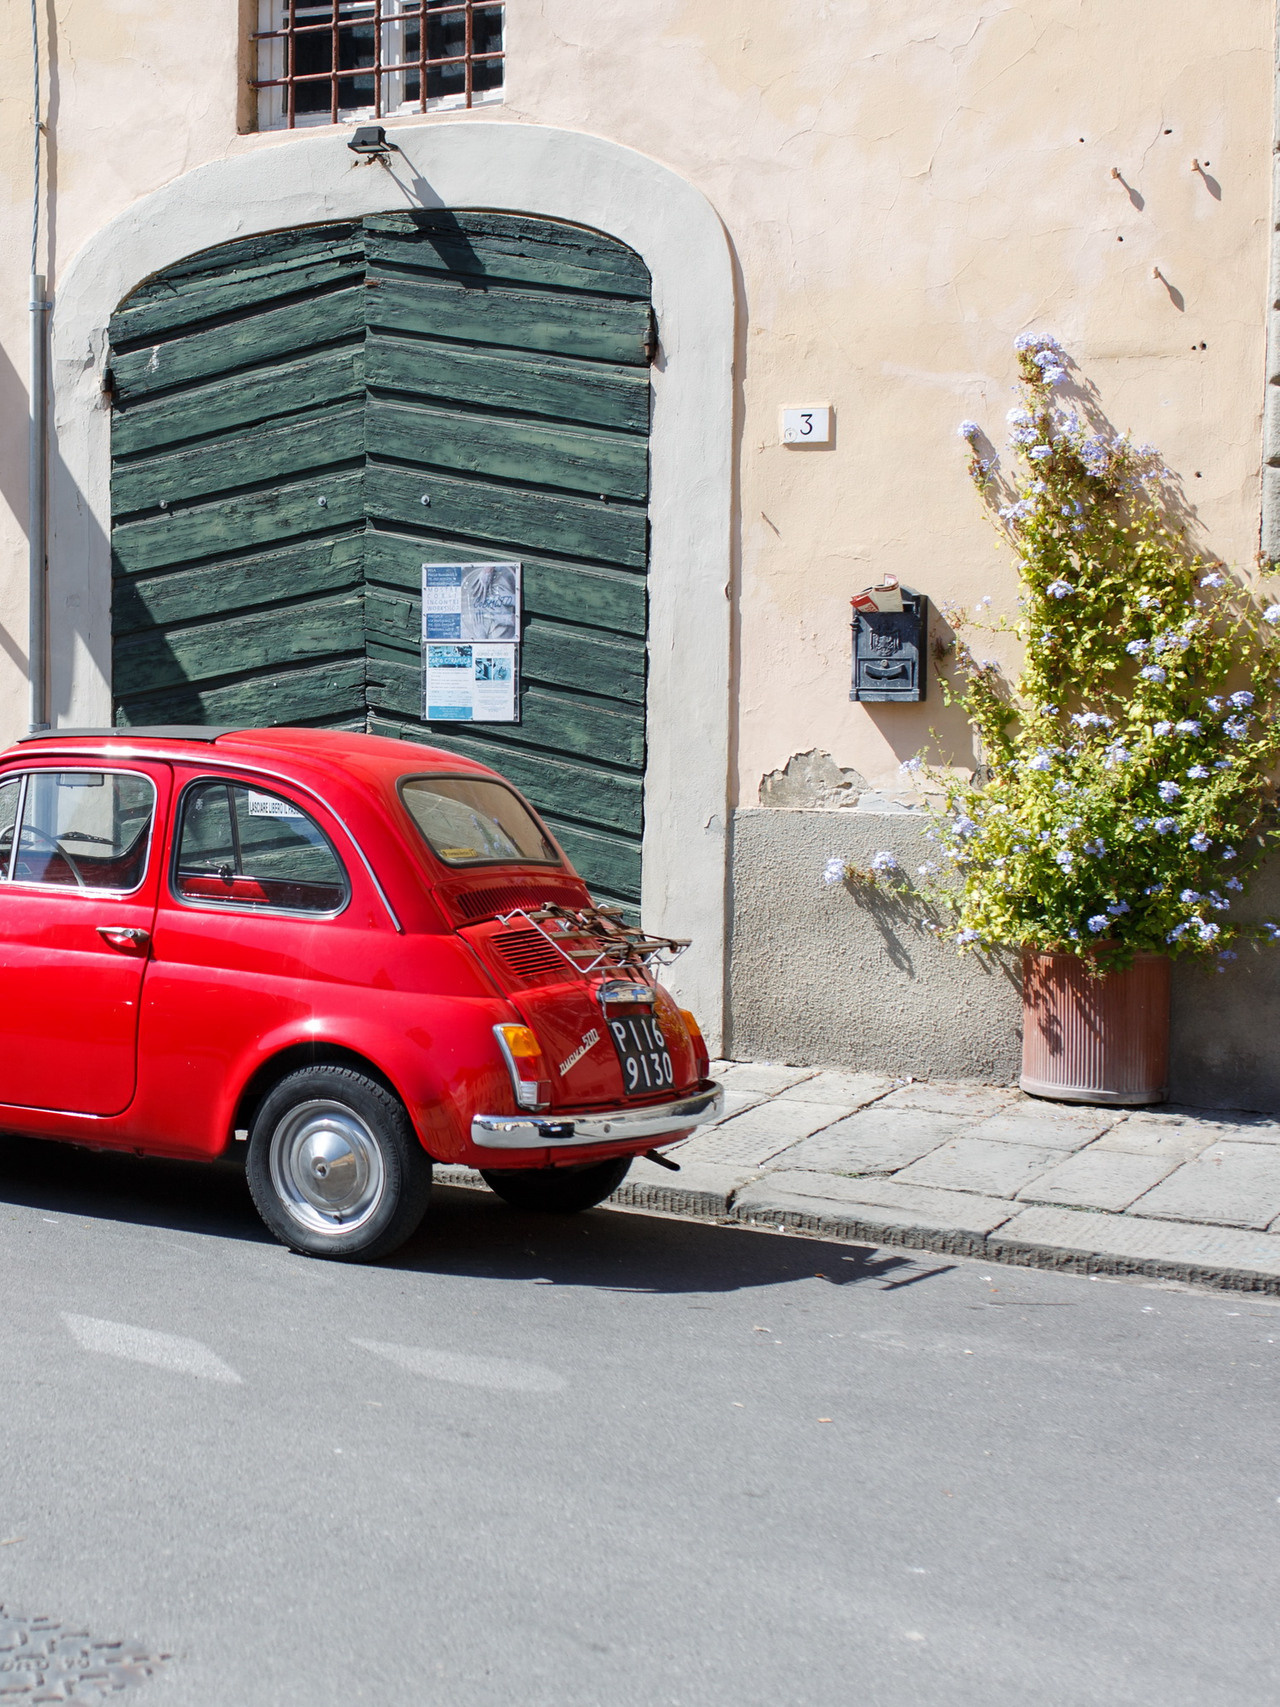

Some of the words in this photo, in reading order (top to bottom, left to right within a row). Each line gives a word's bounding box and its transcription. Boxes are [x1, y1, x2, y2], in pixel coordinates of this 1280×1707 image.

[799, 413, 814, 436] 3
[269, 801, 283, 814] LIBERO
[559, 1045, 584, 1077] nuova
[581, 1028, 600, 1049] 500
[626, 1051, 673, 1090] 9130
